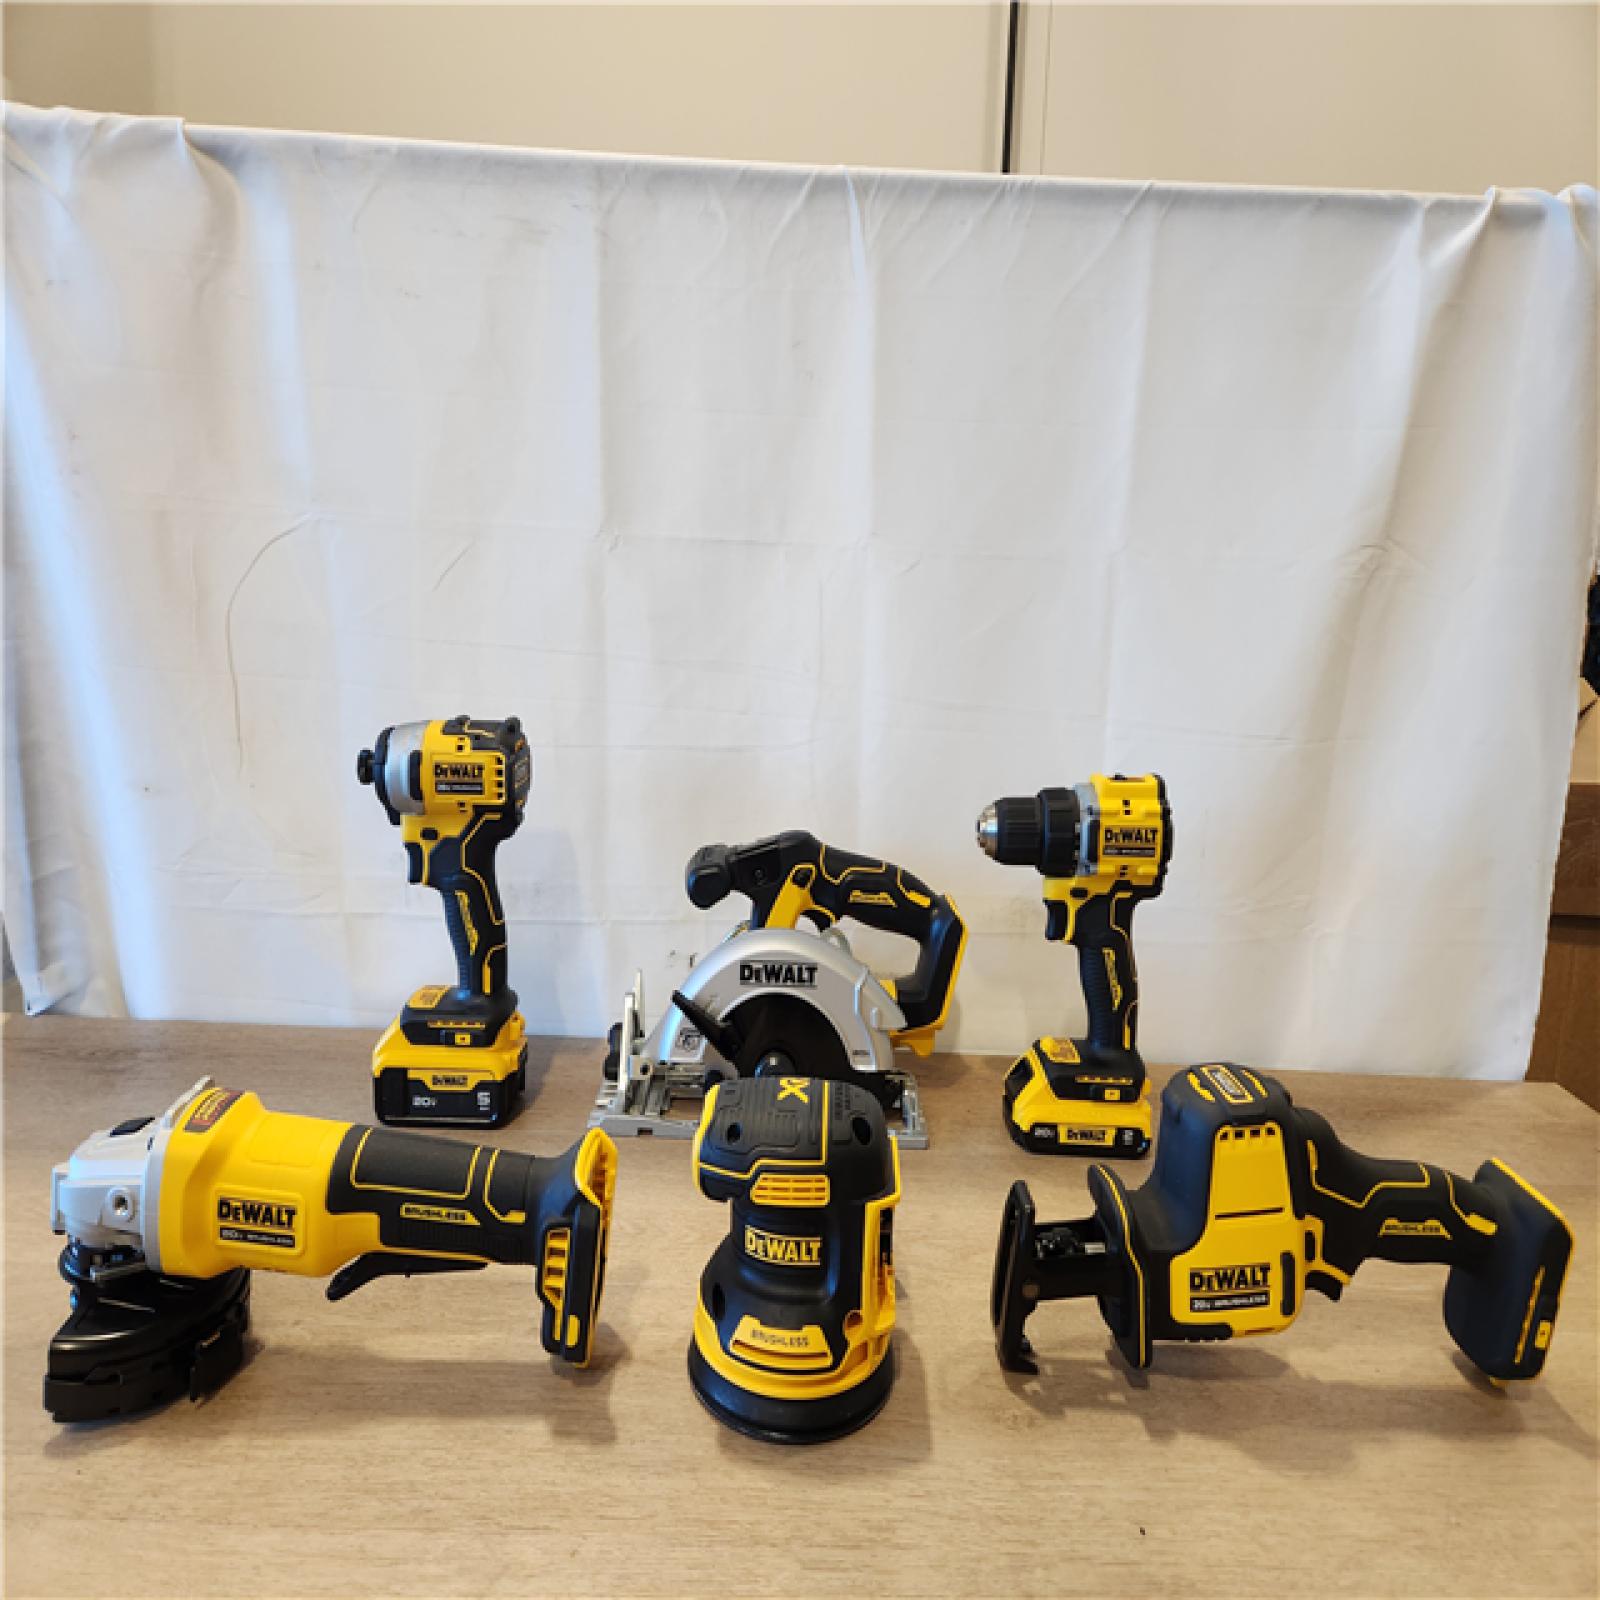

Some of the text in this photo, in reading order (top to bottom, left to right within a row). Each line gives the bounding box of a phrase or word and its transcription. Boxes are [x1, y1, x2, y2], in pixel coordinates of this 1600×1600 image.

[1104, 828, 1158, 846] DEWALT
[739, 963, 818, 986] DEWALT
[218, 1198, 297, 1227] DEWALT
[744, 1226, 822, 1265] DEWALT
[1189, 1264, 1271, 1292] DEWALT
[751, 1327, 810, 1348] BRUSHLESS
